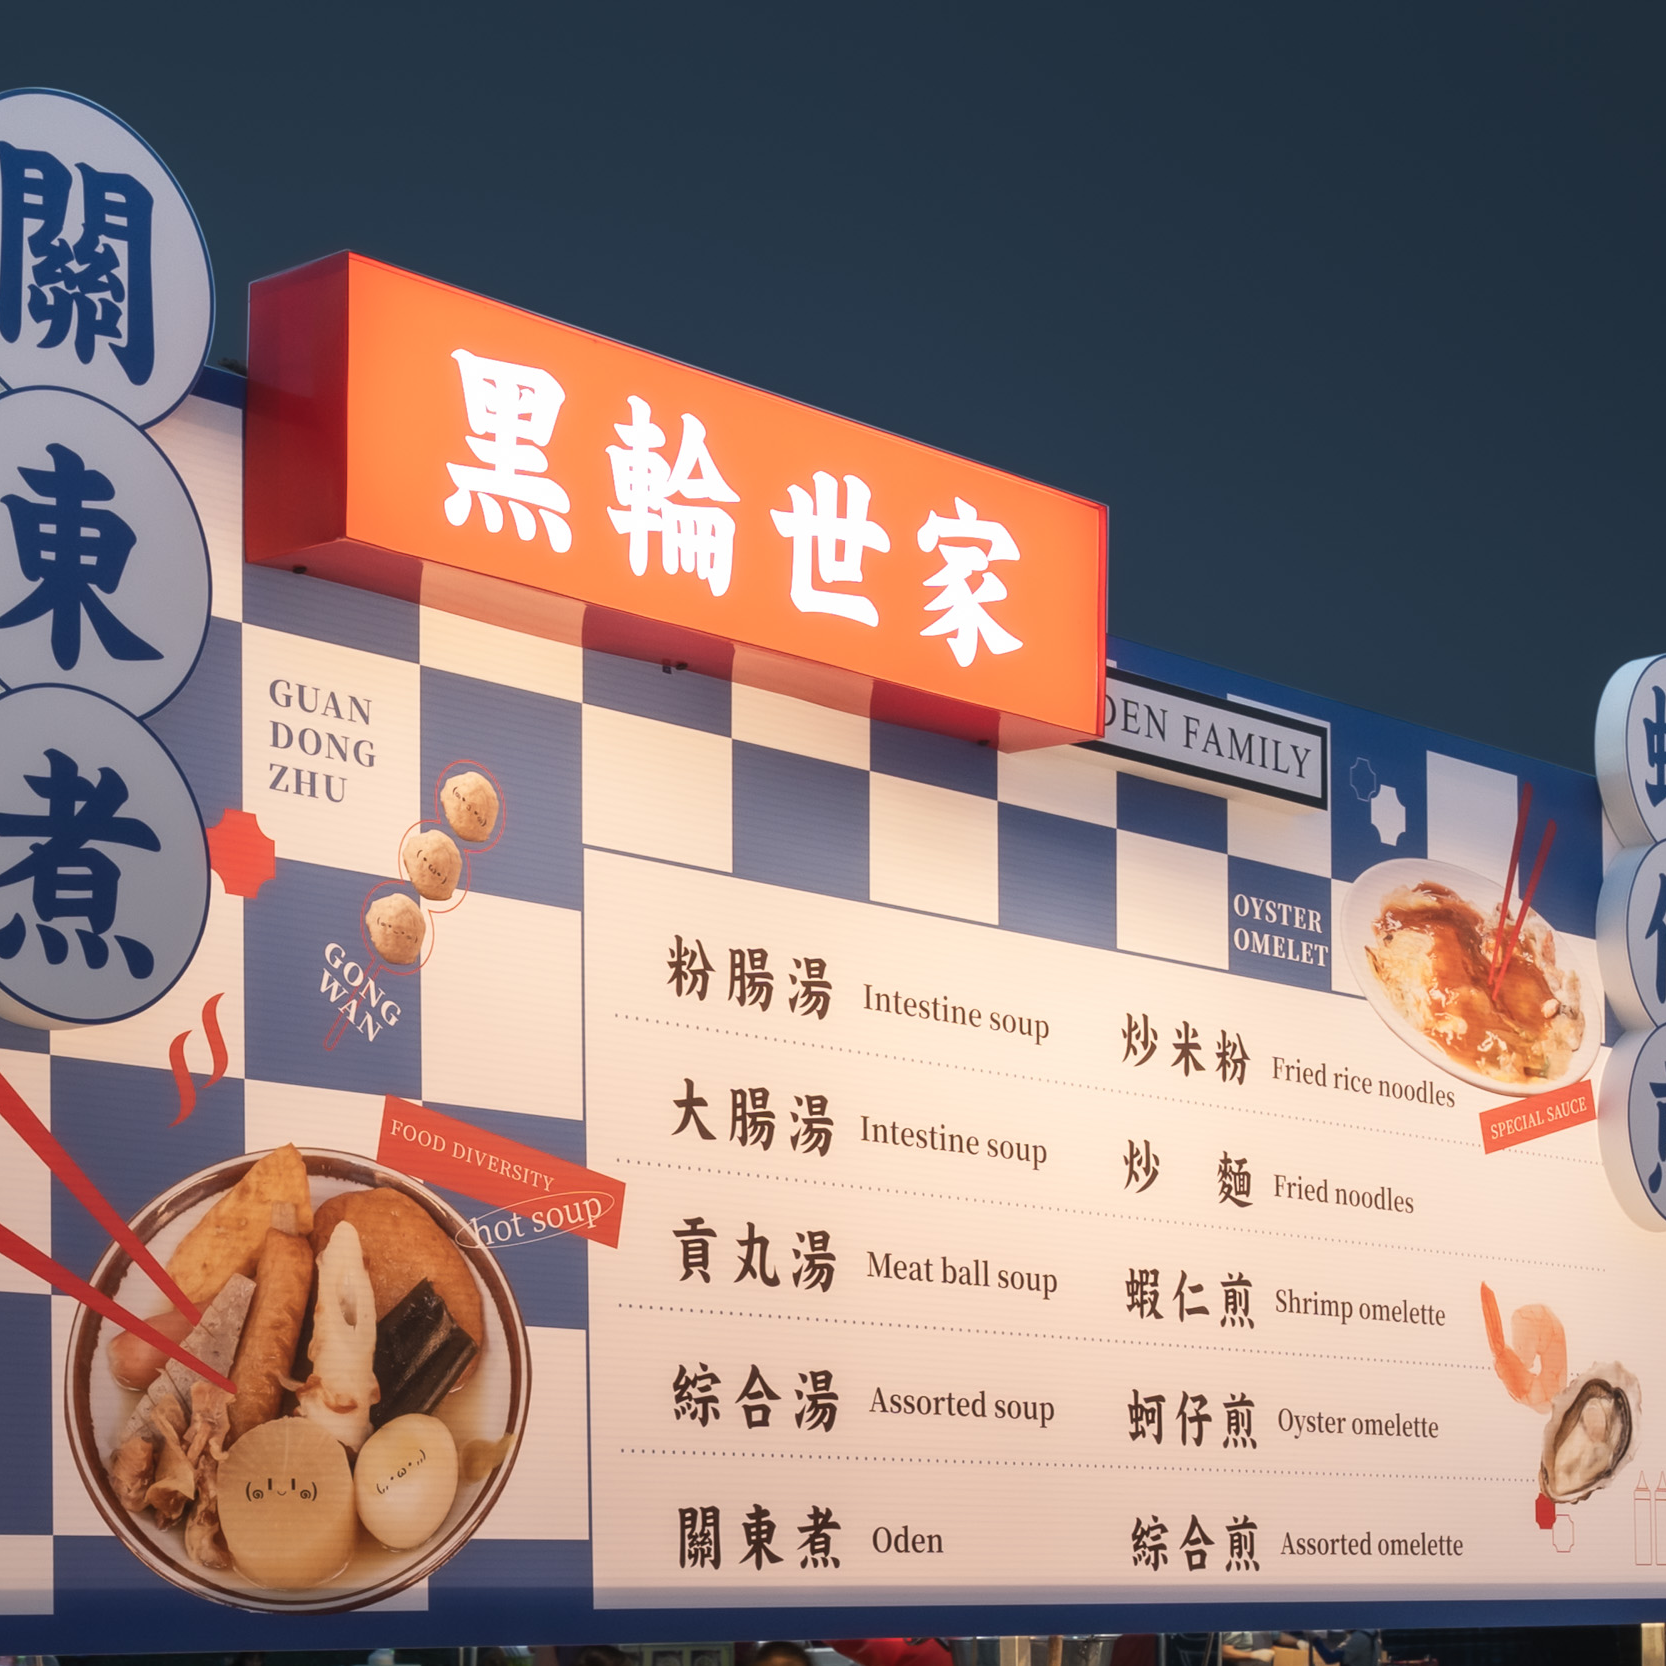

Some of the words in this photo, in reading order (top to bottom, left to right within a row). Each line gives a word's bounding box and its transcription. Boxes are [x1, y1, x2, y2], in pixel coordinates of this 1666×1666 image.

[444, 348, 1024, 668] 黑輪世家
[268, 679, 372, 726] GUAN
[268, 720, 377, 768] DONG
[1183, 714, 1311, 779] FAMILY
[268, 763, 347, 803] ZHU
[1233, 893, 1323, 934] OYSTER
[1233, 927, 1329, 968] OMELET
[317, 968, 384, 1042] WAN
[324, 942, 402, 1027] GONG
[666, 934, 832, 1020] 粉腸湯
[863, 983, 983, 1029] Intestine
[988, 1010, 1051, 1046] soup
[1121, 1013, 1251, 1086] 炒米粉
[1271, 1056, 1327, 1088] Fried
[1332, 1065, 1373, 1095] rice
[1378, 1074, 1456, 1109] noodles
[671, 1078, 835, 1158] 大腸湯
[859, 1115, 981, 1157] Intestine
[986, 1134, 1048, 1171] soup
[1489, 1108, 1543, 1141] SPECIAL
[1546, 1096, 1588, 1128] SAUCE
[390, 1119, 446, 1152] FOOD
[452, 1141, 555, 1192] DIVERSITY
[470, 1212, 525, 1247] hot
[531, 1197, 603, 1233] soup
[1273, 1174, 1329, 1204] Fried
[1334, 1182, 1415, 1214] noodles
[672, 1217, 837, 1292] 貢丸湯
[866, 1251, 934, 1285] Meat
[941, 1254, 990, 1288] ball
[997, 1268, 1059, 1300] soup
[1125, 1268, 1255, 1330] 蝦仁煎
[1275, 1288, 1354, 1323] Shrimp
[1358, 1297, 1446, 1327] omelette
[672, 1362, 839, 1433] 綜合湯
[869, 1386, 988, 1419] Assorted
[994, 1396, 1055, 1428] soup
[1127, 1389, 1258, 1450] 蚵仔煎
[1278, 1407, 1346, 1441] Oyster
[1351, 1411, 1440, 1439] omelette
[678, 1503, 842, 1571] 關東煮
[872, 1525, 944, 1556] Oden
[1131, 1514, 1260, 1572] 綜合煎
[1280, 1531, 1373, 1557] Assorted
[1377, 1533, 1464, 1558] omelette
